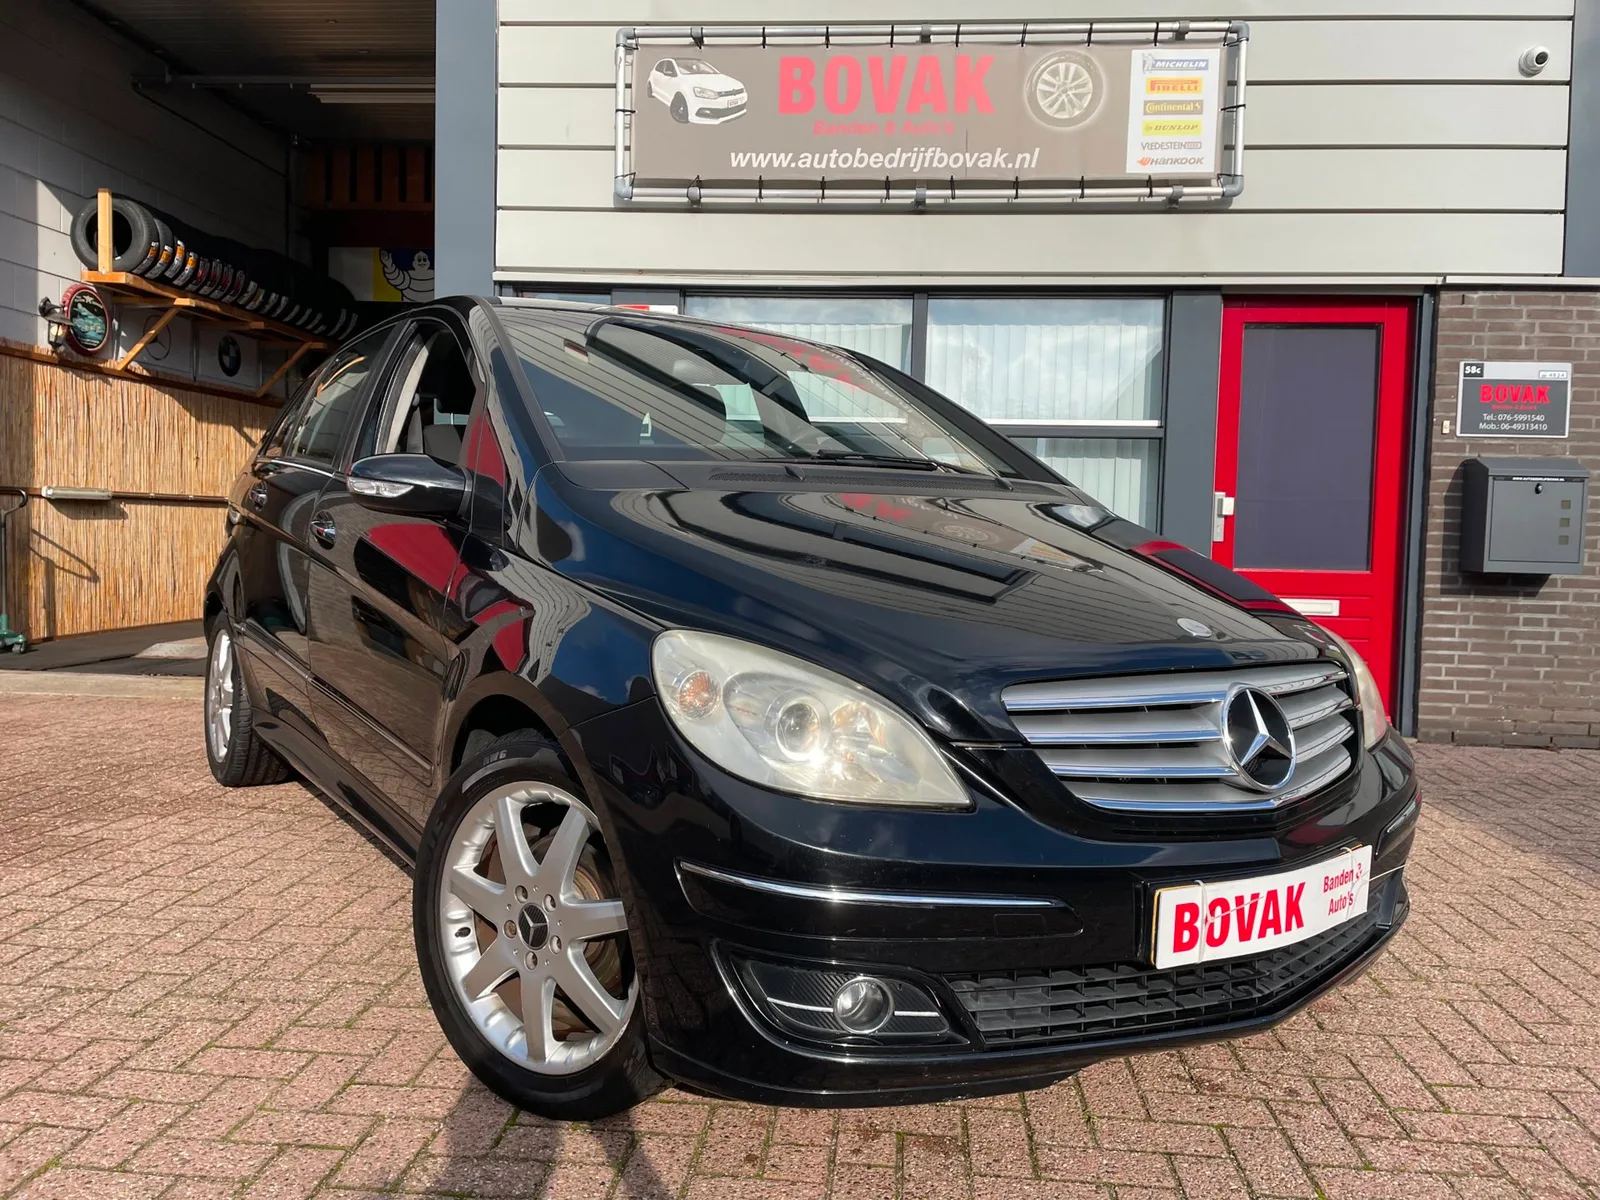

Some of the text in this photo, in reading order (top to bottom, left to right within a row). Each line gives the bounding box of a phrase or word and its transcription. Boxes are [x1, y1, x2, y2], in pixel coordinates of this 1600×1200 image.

[778, 54, 996, 115] BOVAK
[1150, 79, 1199, 92] PIRELLI
[1145, 102, 1194, 113] Continental
[813, 119, 956, 135] Banden & Auto's
[1141, 141, 1186, 151] VREDESTEIN
[730, 147, 1040, 173] www.autobedrijfbovak.nl
[1465, 365, 1482, 374] 58c
[1479, 383, 1551, 404] BOVAK
[1497, 413, 1545, 422] 076-5991540
[1500, 422, 1548, 431] 06-49313410
[1323, 869, 1354, 893] Banden
[1327, 891, 1354, 916] Auto's
[1172, 881, 1306, 953] BOVAK
